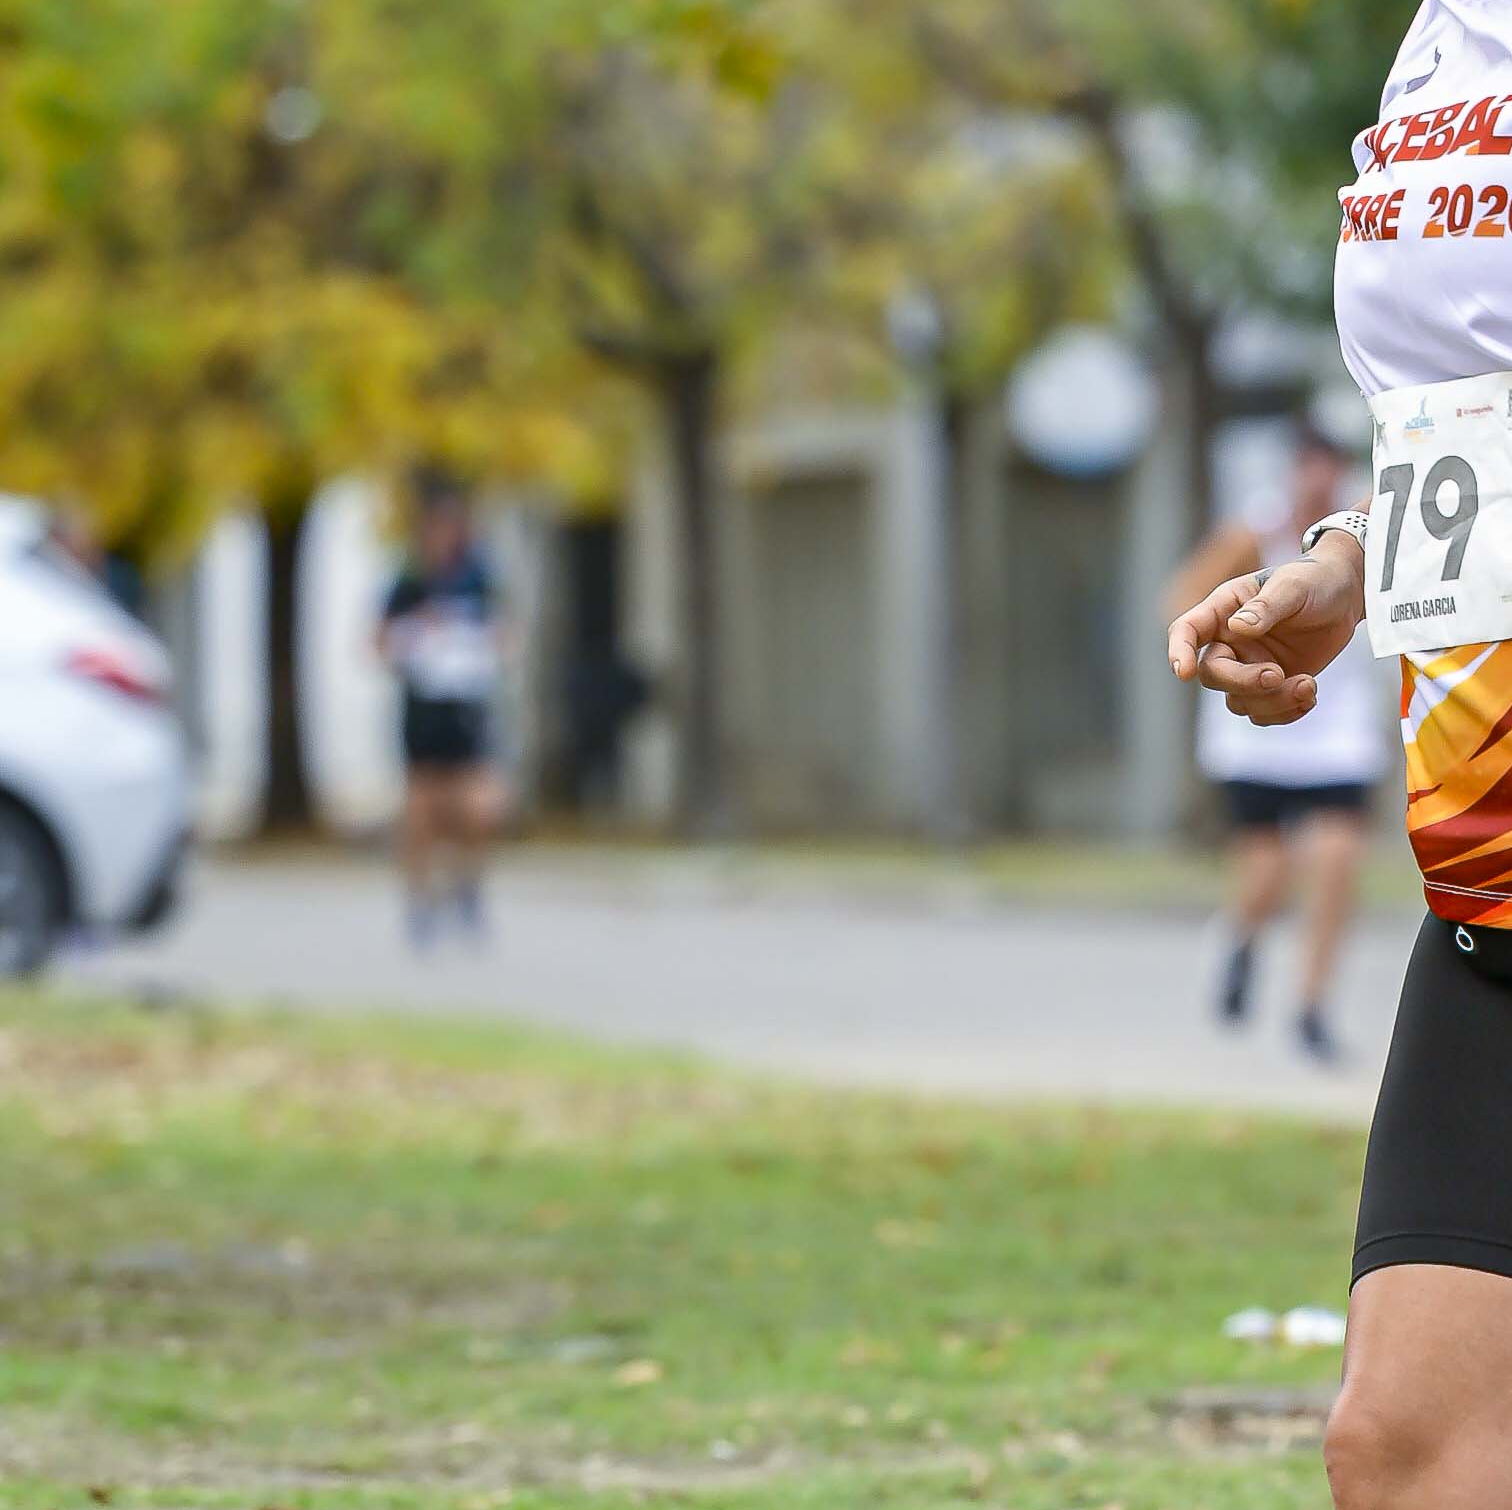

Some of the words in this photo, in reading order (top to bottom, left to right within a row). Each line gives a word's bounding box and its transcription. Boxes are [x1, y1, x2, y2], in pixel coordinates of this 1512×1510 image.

[1379, 455, 1478, 592] 79
[1390, 601, 1422, 623] LORENA
[1422, 595, 1457, 618] GARCIA
